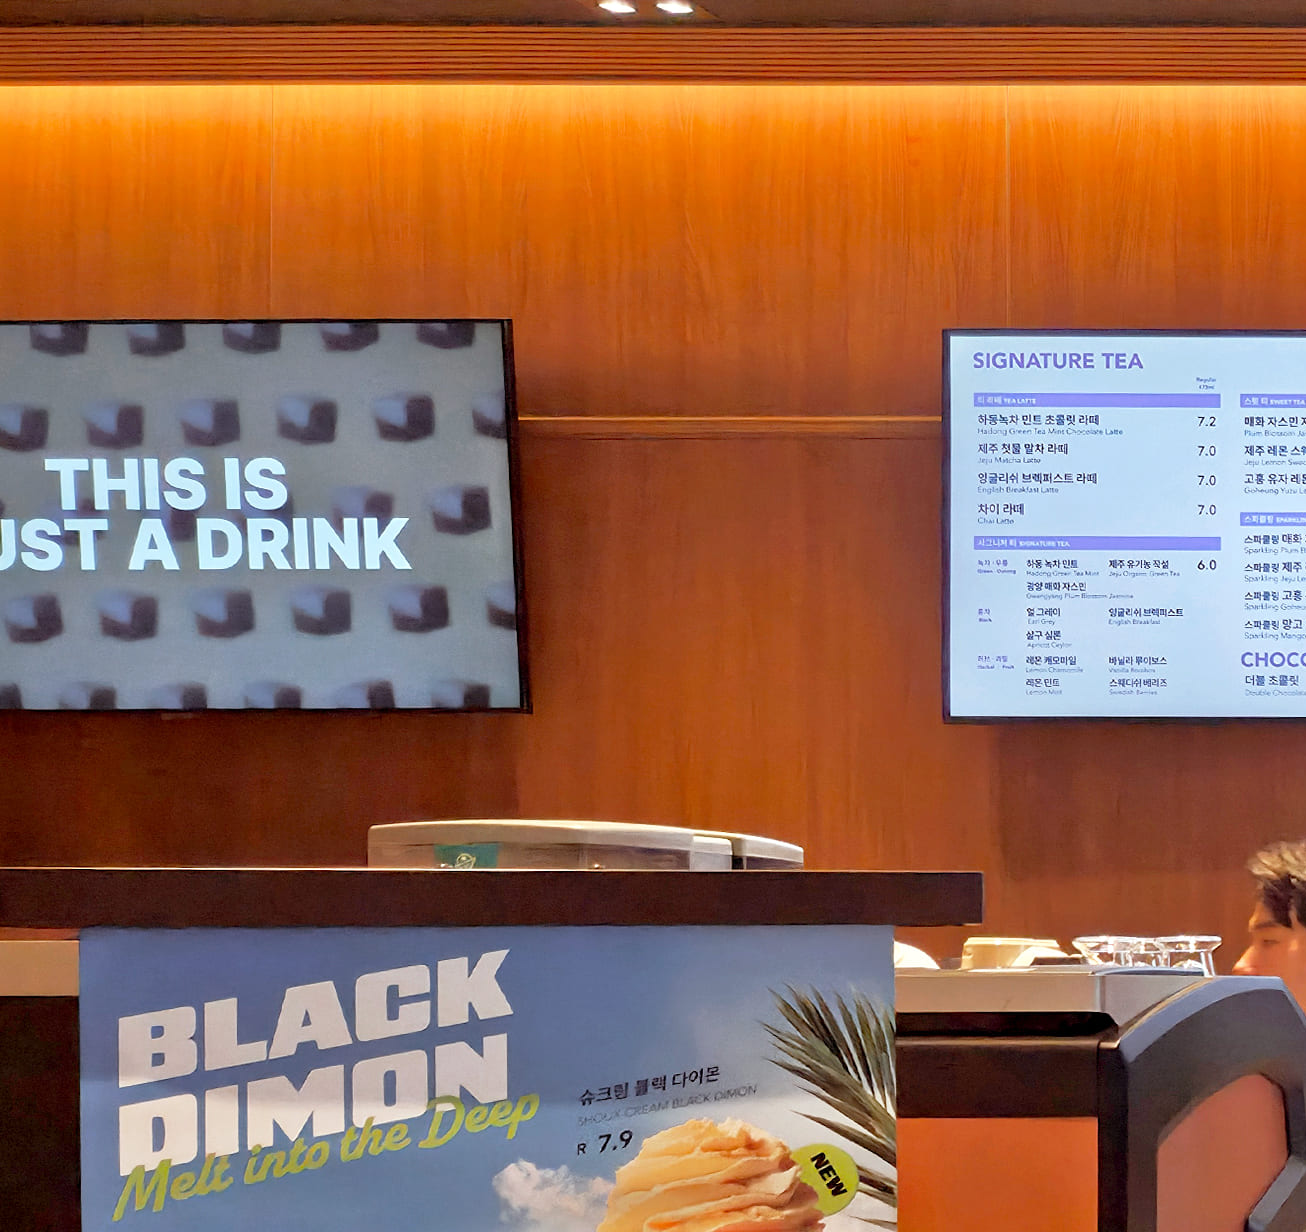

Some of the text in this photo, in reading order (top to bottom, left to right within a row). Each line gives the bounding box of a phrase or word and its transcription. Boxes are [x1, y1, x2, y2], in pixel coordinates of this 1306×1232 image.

[973, 352, 1144, 369] SIGNATURE TEA
[1022, 414, 1041, 425] 민트
[1045, 414, 1075, 425] 초콜릿
[1079, 414, 1099, 425] 라떼
[1198, 417, 1216, 426] 7.2
[1267, 416, 1298, 428] 자스민
[44, 458, 288, 511] THIS IS
[978, 473, 1097, 484] 잉글리쉬 브렉퍼스트 라떼
[1198, 475, 1216, 486] 7.0
[978, 486, 1004, 494] English
[1006, 486, 1039, 494] Breakfast
[128, 519, 180, 570] A
[197, 518, 412, 570] DRINK
[1245, 675, 1299, 686] 더블 초콜릿
[119, 949, 513, 1087] BLACK
[119, 1033, 508, 1176] DIMON
[577, 1130, 633, 1155] R 7.9
[112, 1094, 539, 1222] Melt into the Deep
[811, 1152, 847, 1197] NEW
